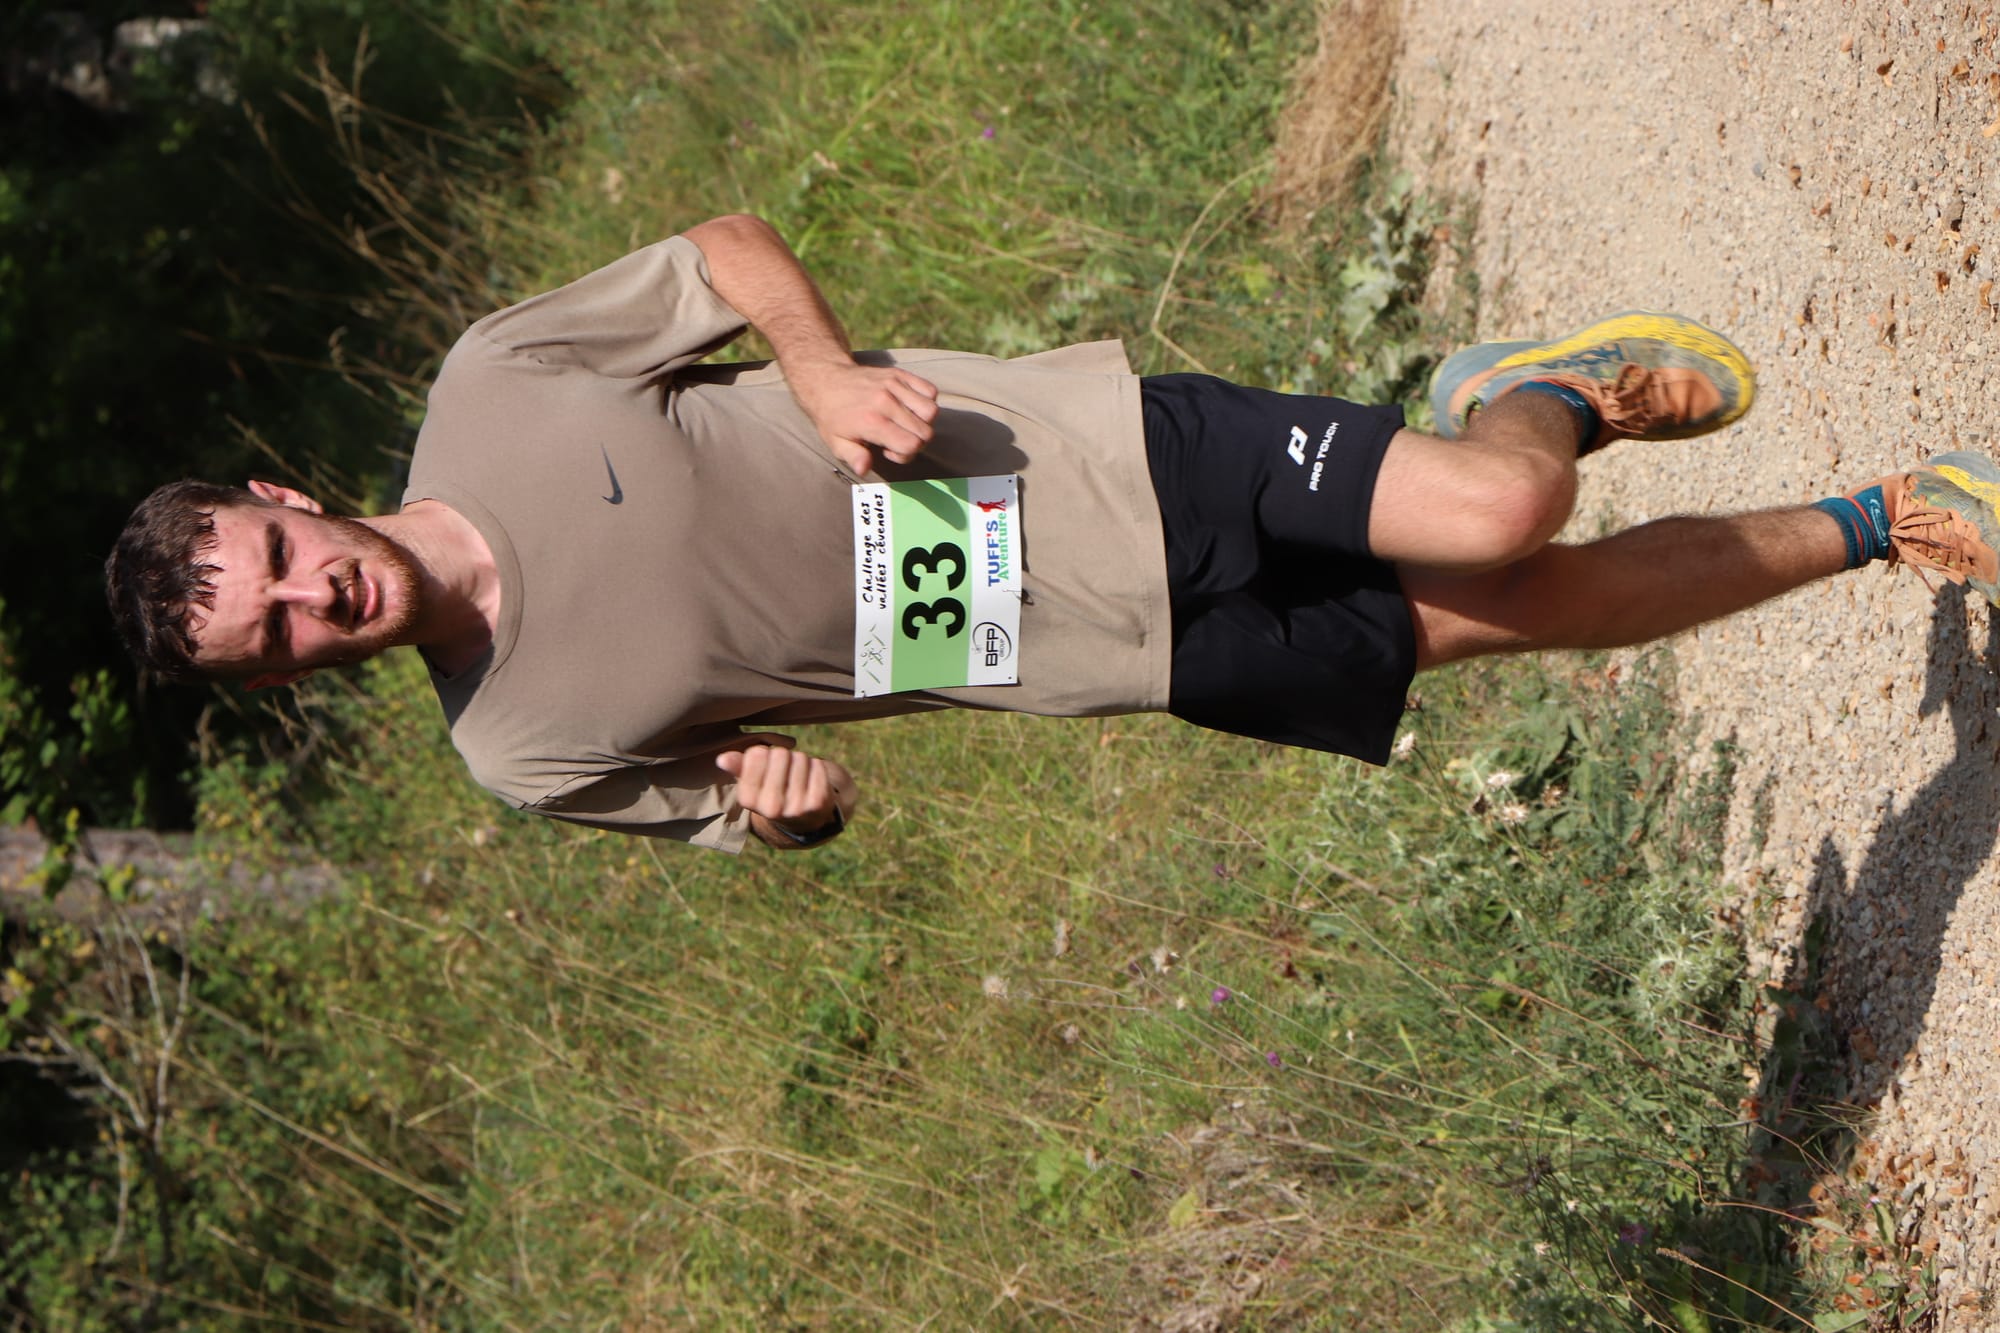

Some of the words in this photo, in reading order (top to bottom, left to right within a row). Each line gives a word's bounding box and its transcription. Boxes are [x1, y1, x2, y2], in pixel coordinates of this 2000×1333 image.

[1316, 421, 1340, 459] TOUCH
[1309, 461, 1324, 491] PRO
[860, 502, 870, 526] des
[874, 493, 886, 554] cévenoles
[862, 534, 876, 603] Challenge
[986, 520, 1001, 587] TUFF'S
[997, 512, 1009, 580] Aventure
[875, 563, 887, 610] vallées
[902, 541, 966, 640] 33
[985, 628, 999, 667] BFP
